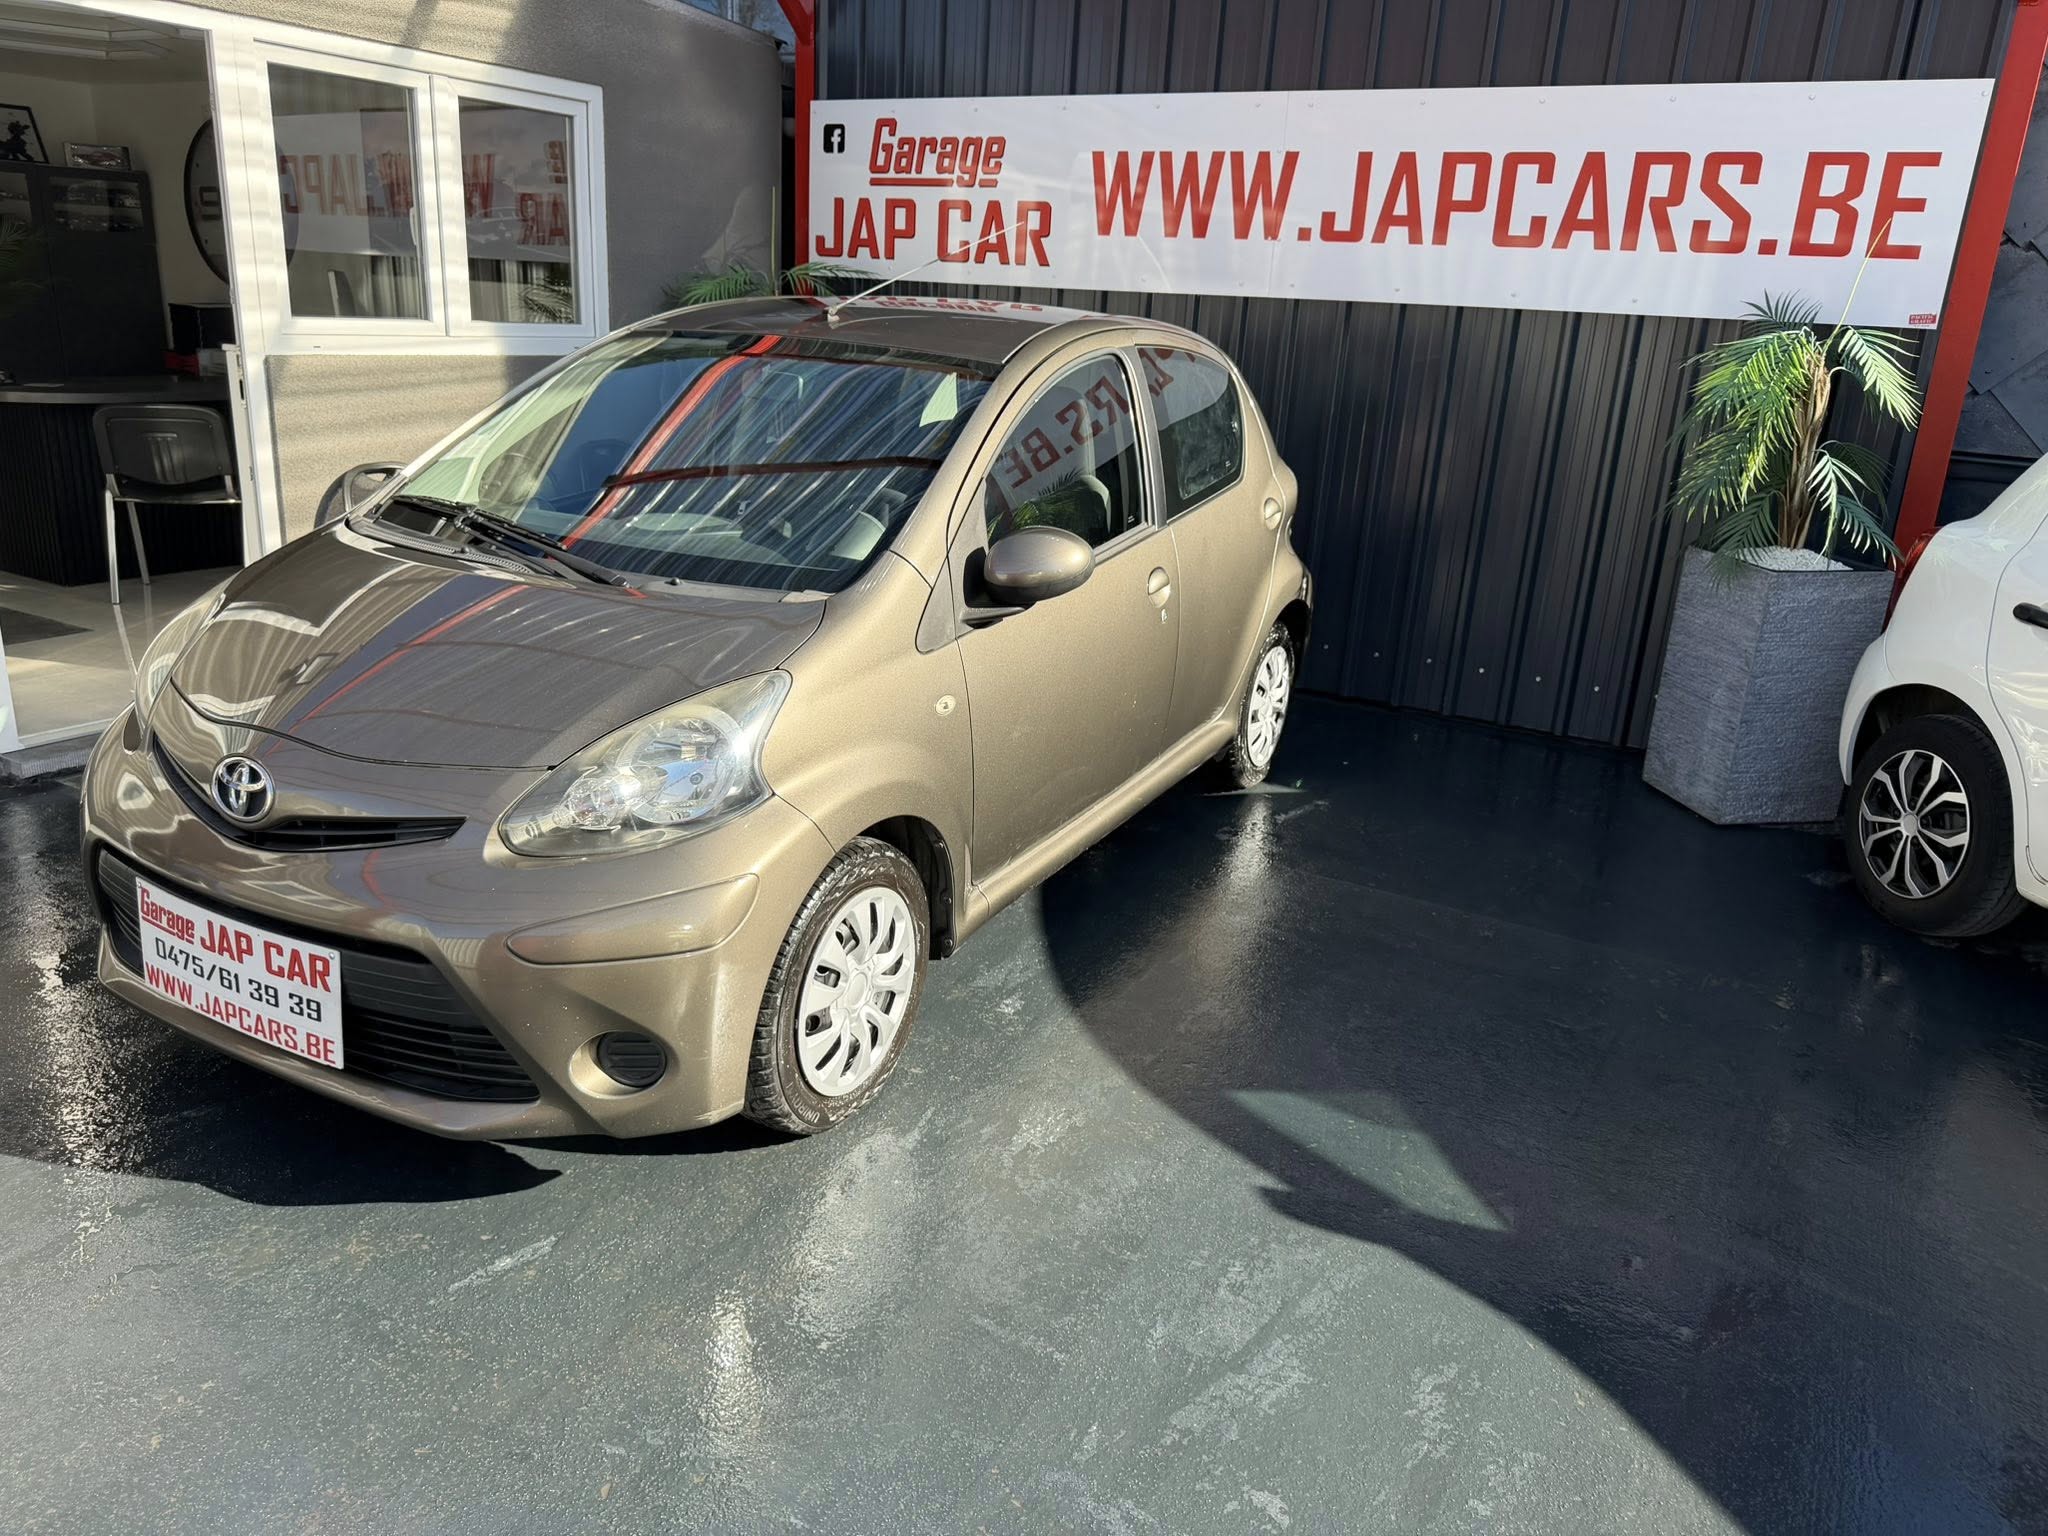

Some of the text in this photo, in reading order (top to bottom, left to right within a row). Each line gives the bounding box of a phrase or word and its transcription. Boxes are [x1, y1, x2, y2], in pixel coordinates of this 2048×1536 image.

[869, 117, 1006, 188] Garage
[815, 196, 1052, 267] JAP CAR
[1091, 151, 1943, 260] WWW.JAPCARS.BE
[140, 887, 331, 992] Garage JAP CAR
[155, 937, 322, 1022] 0475/61 39 39
[145, 961, 336, 1065] WWW.JAPCARS.BE
